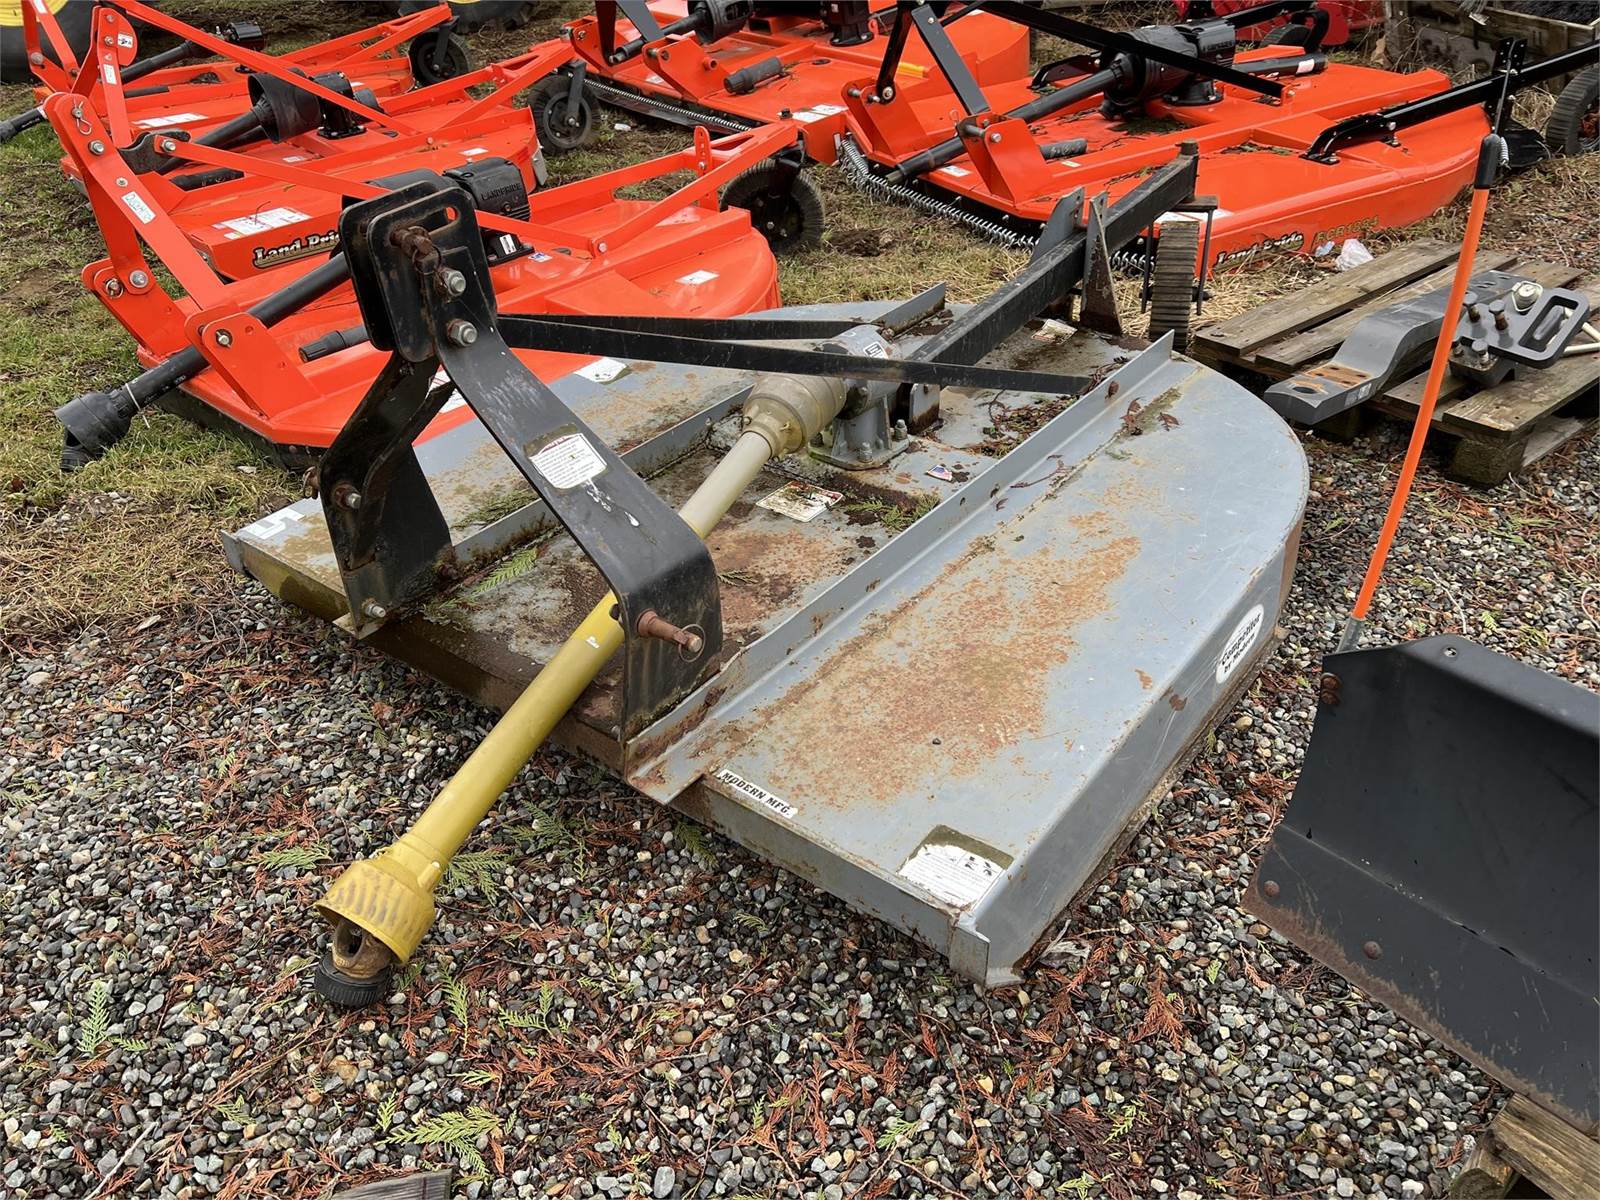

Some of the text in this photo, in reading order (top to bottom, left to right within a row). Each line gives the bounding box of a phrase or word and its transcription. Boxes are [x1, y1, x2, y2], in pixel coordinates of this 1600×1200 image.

[254, 238, 303, 262] Land
[1217, 243, 1259, 264] Land
[722, 772, 791, 816] MODERN MFG.
